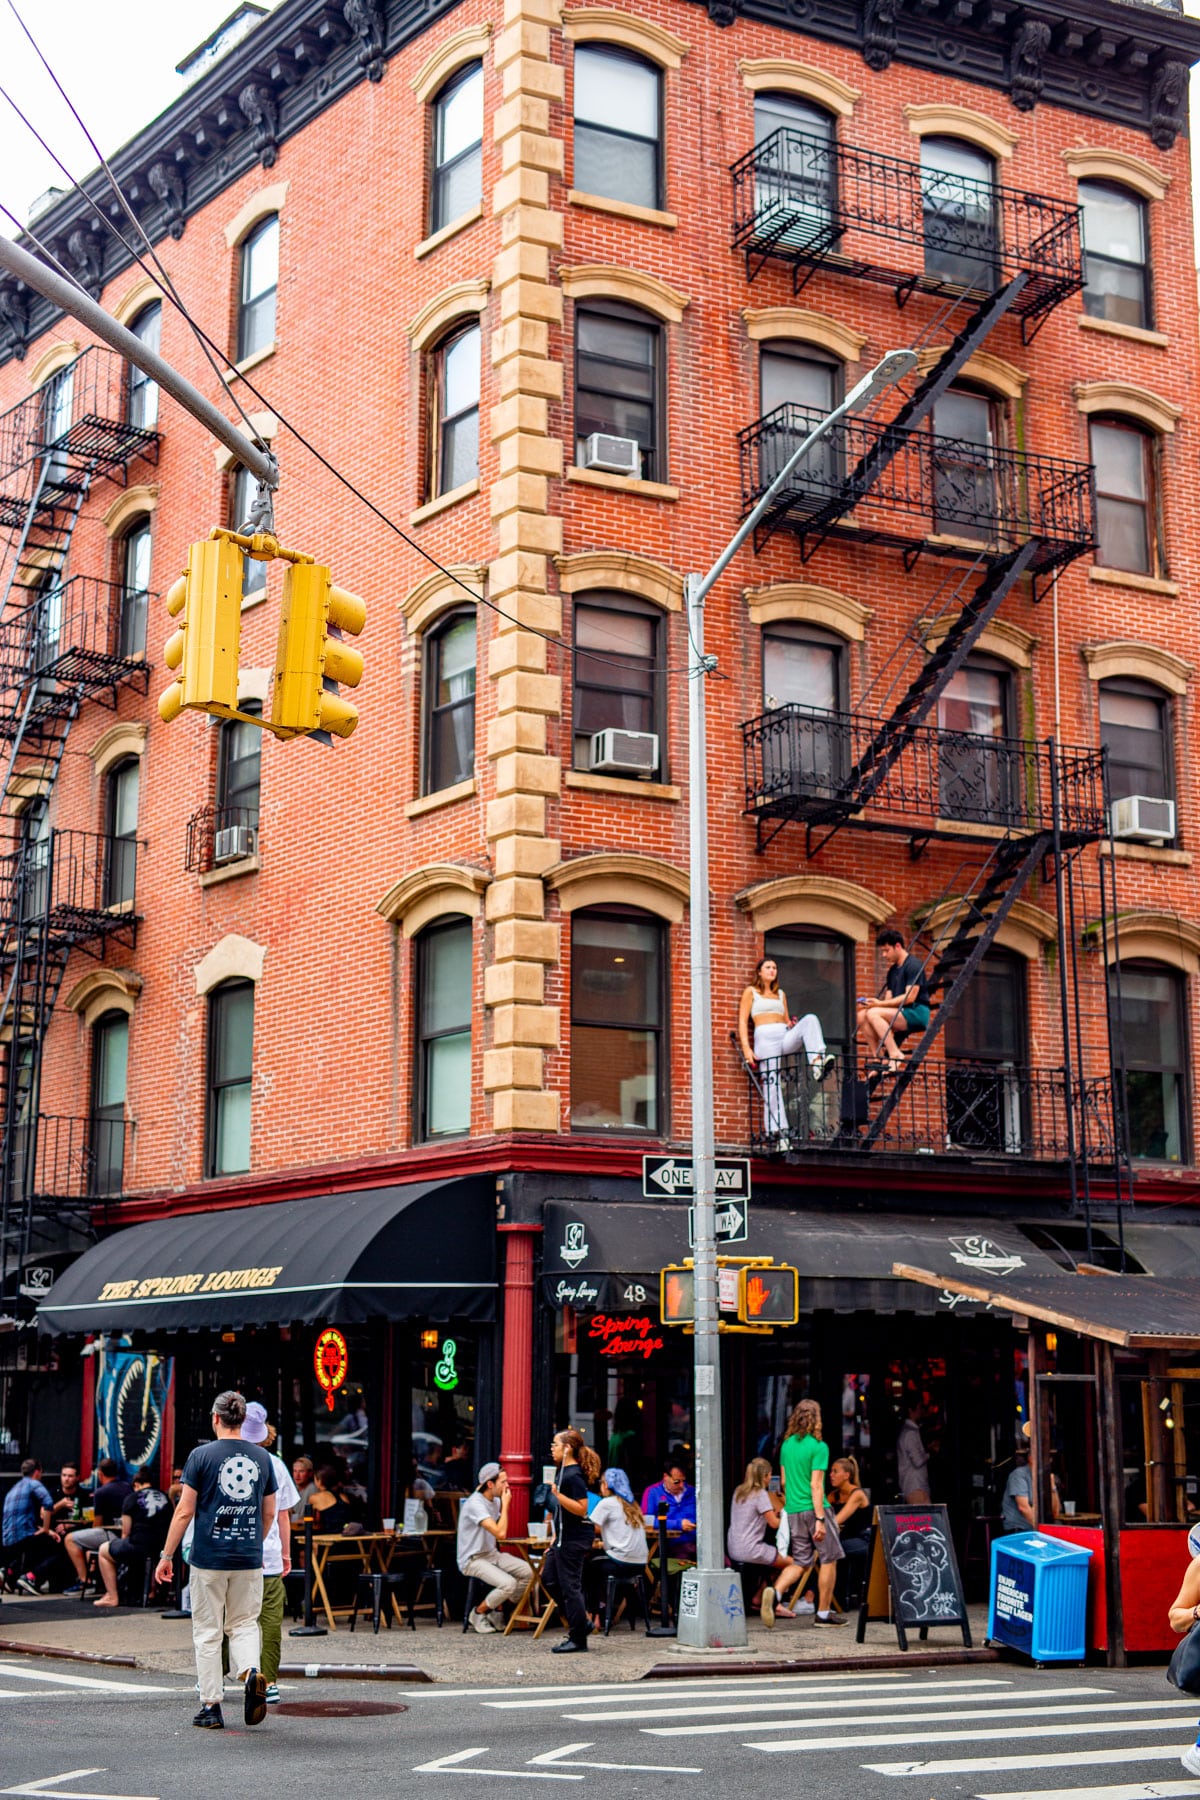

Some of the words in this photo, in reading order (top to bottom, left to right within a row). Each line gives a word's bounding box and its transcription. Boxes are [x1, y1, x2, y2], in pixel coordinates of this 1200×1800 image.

[661, 1170, 690, 1184] ONE
[716, 1171, 735, 1185] AY
[720, 1213, 738, 1230] WAY
[98, 1279, 138, 1300] THE
[134, 1273, 204, 1298] SPRING
[199, 1266, 283, 1292] LOUNGE
[623, 1285, 646, 1302] 48
[588, 1314, 652, 1339] Spring
[600, 1336, 663, 1358] Lounge
